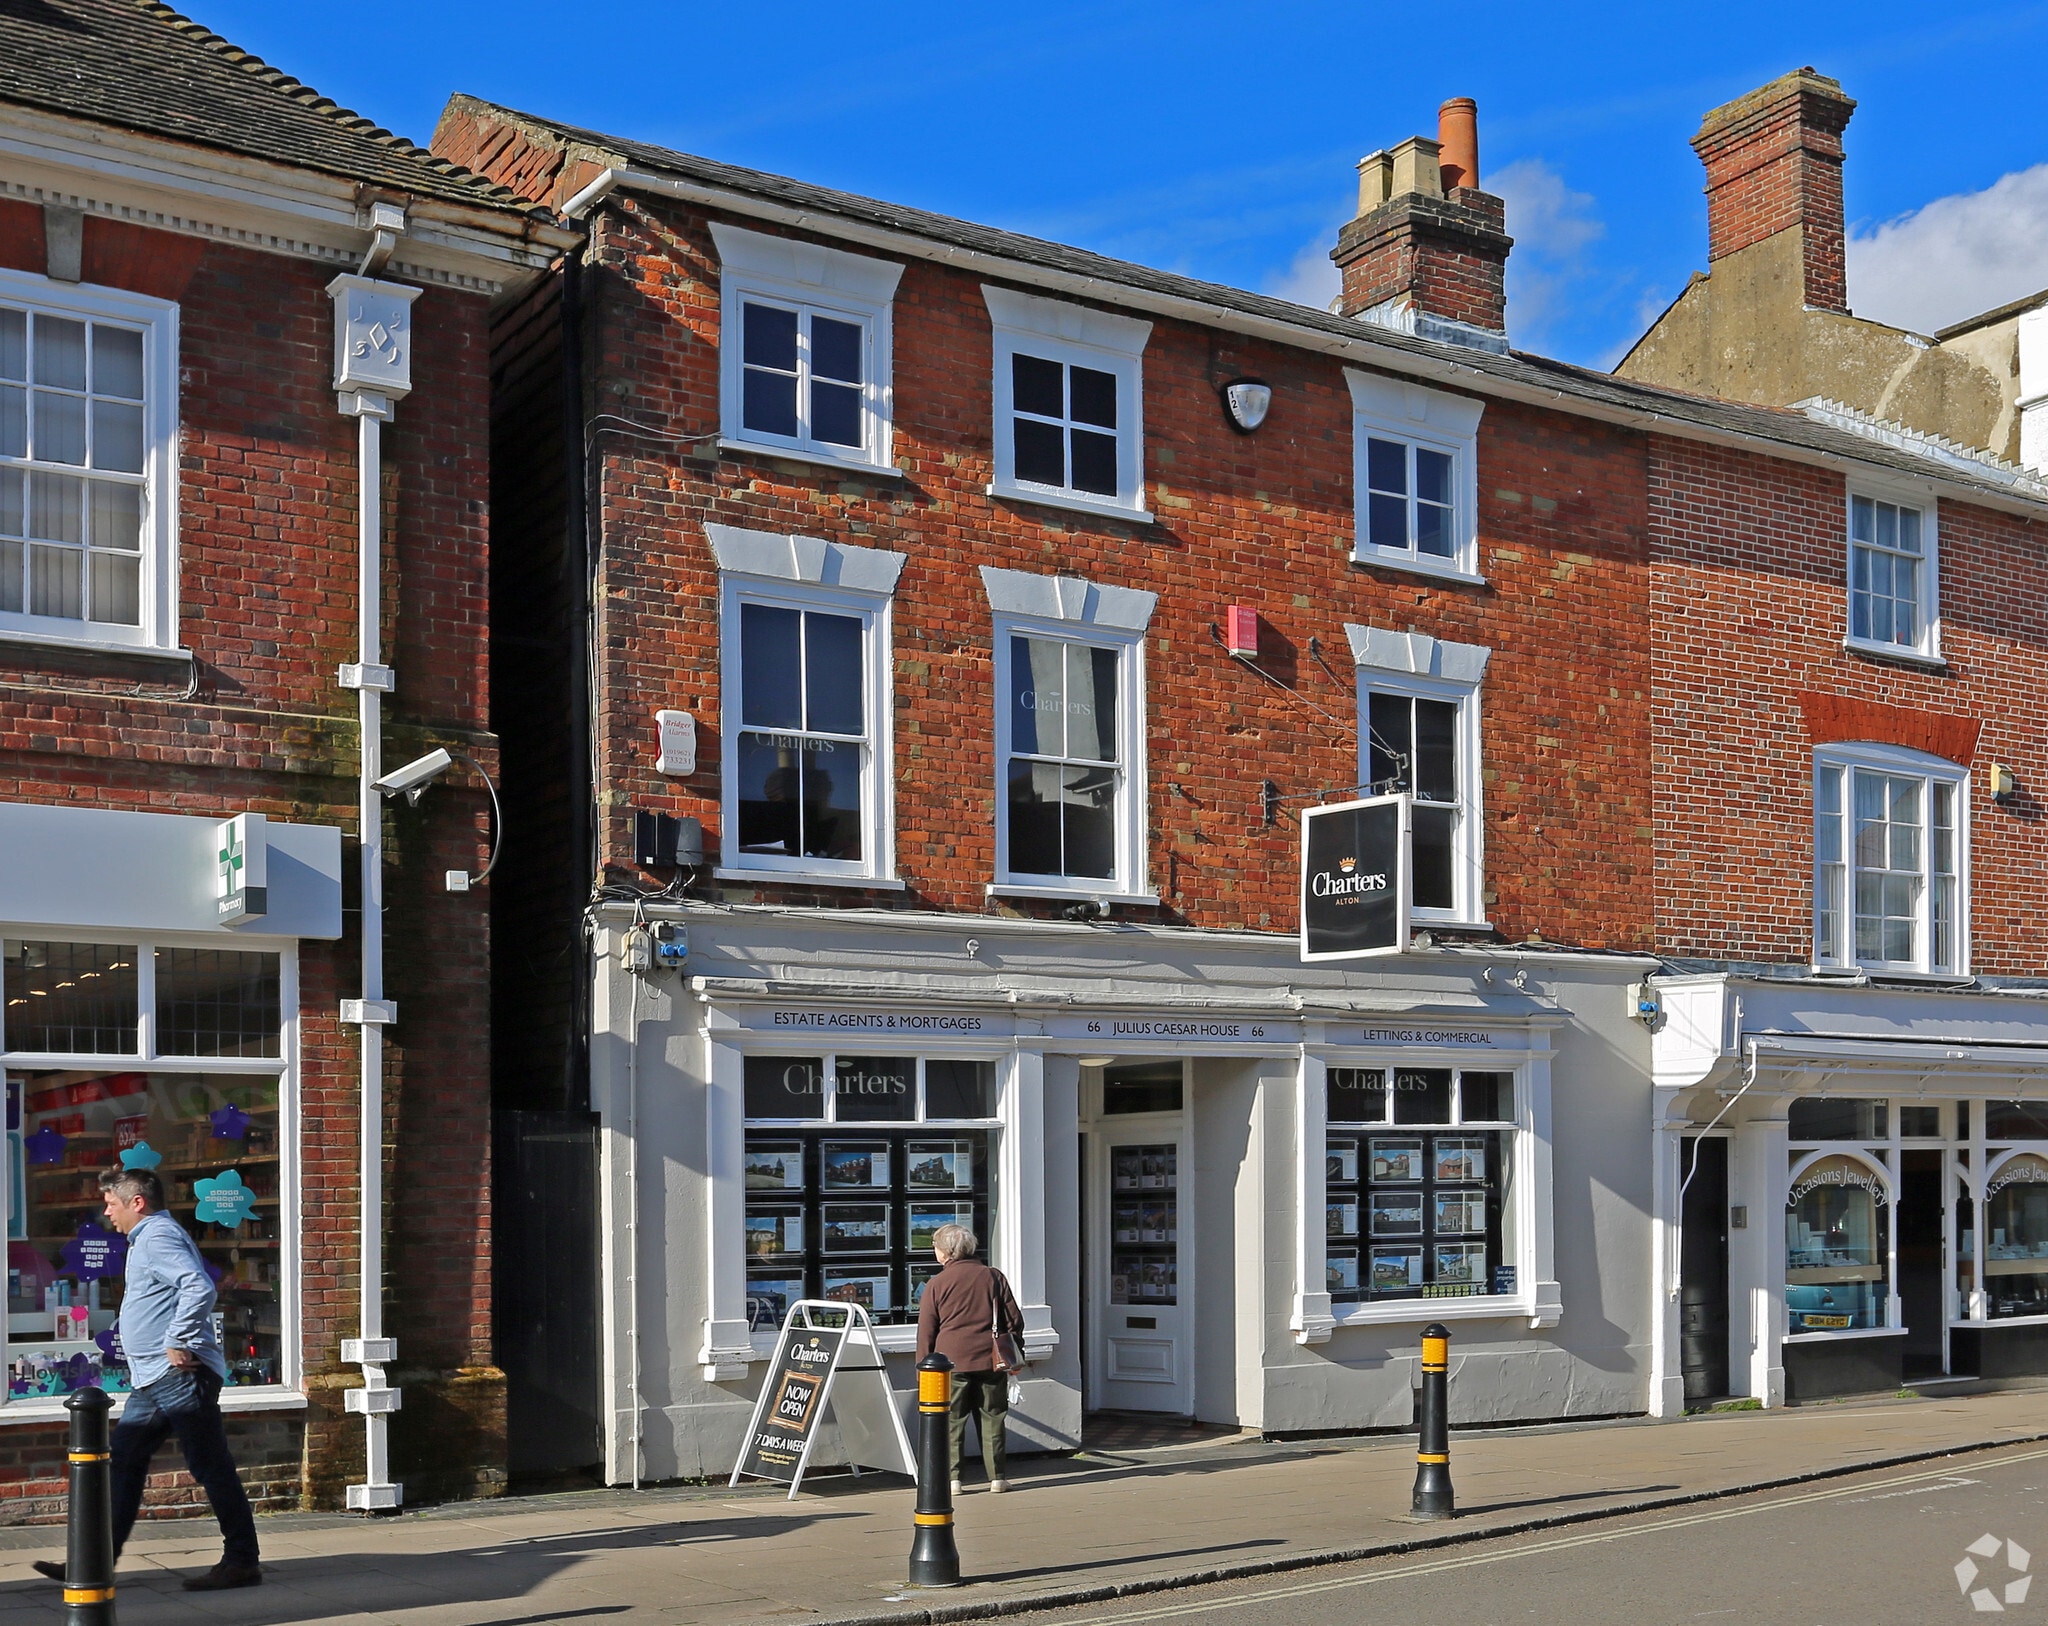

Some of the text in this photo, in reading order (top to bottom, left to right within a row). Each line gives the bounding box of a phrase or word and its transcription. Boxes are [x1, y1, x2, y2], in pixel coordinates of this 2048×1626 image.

[1020, 690, 1091, 715] Charers
[665, 719, 691, 729] Bridger
[1312, 872, 1387, 897] Charters
[218, 896, 243, 915] Pharmacy
[1335, 896, 1360, 906] ALTON
[774, 1011, 982, 1030] ESTATE AGENTS & MORTGAGES
[1087, 1021, 1264, 1037] 66 JULIUS CAESAR HOUSE 66
[1363, 1029, 1492, 1044] LETTINGS & COMMERCIAL
[1335, 1067, 1428, 1092] Charers
[1788, 1165, 1888, 1208] Occasions Jewellery
[790, 1343, 831, 1363] Charters
[785, 1384, 812, 1402] NOW
[780, 1400, 806, 1418] OPEN
[754, 1433, 763, 1445] 7
[761, 1434, 782, 1449] DAYS
[779, 1438, 786, 1450] A
